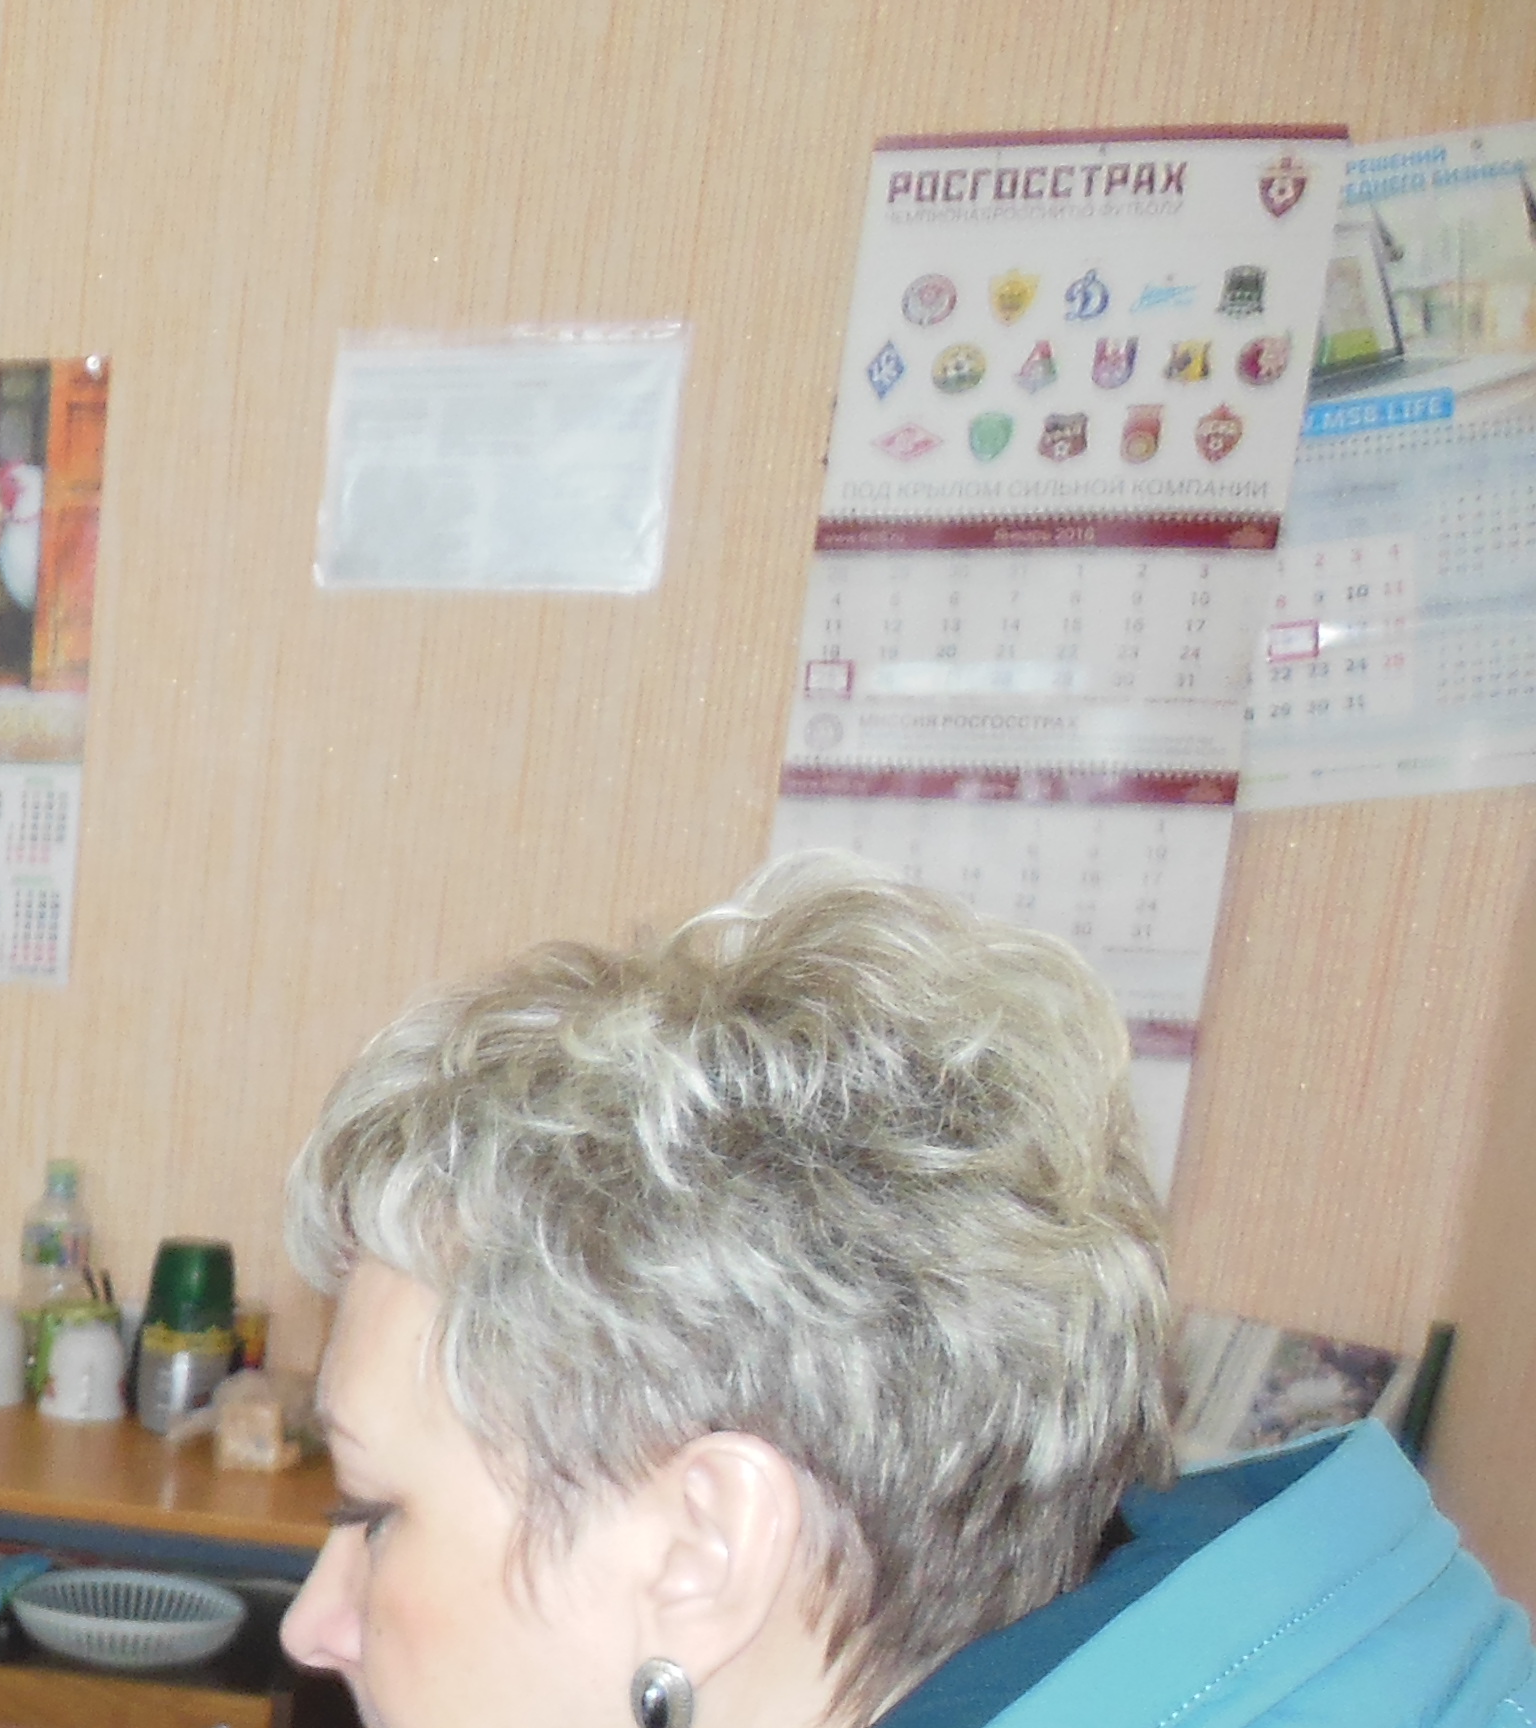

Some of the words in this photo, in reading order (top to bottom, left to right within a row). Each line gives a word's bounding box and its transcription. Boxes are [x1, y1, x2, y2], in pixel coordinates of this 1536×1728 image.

[887, 161, 1188, 203] РОСГОССТРАХ
[897, 480, 1002, 500] КРЫЛОМ
[1008, 476, 1125, 500] СИЛЬНОЙ
[1132, 477, 1270, 499] КОМПАНИИ
[1347, 584, 1368, 600] 10
